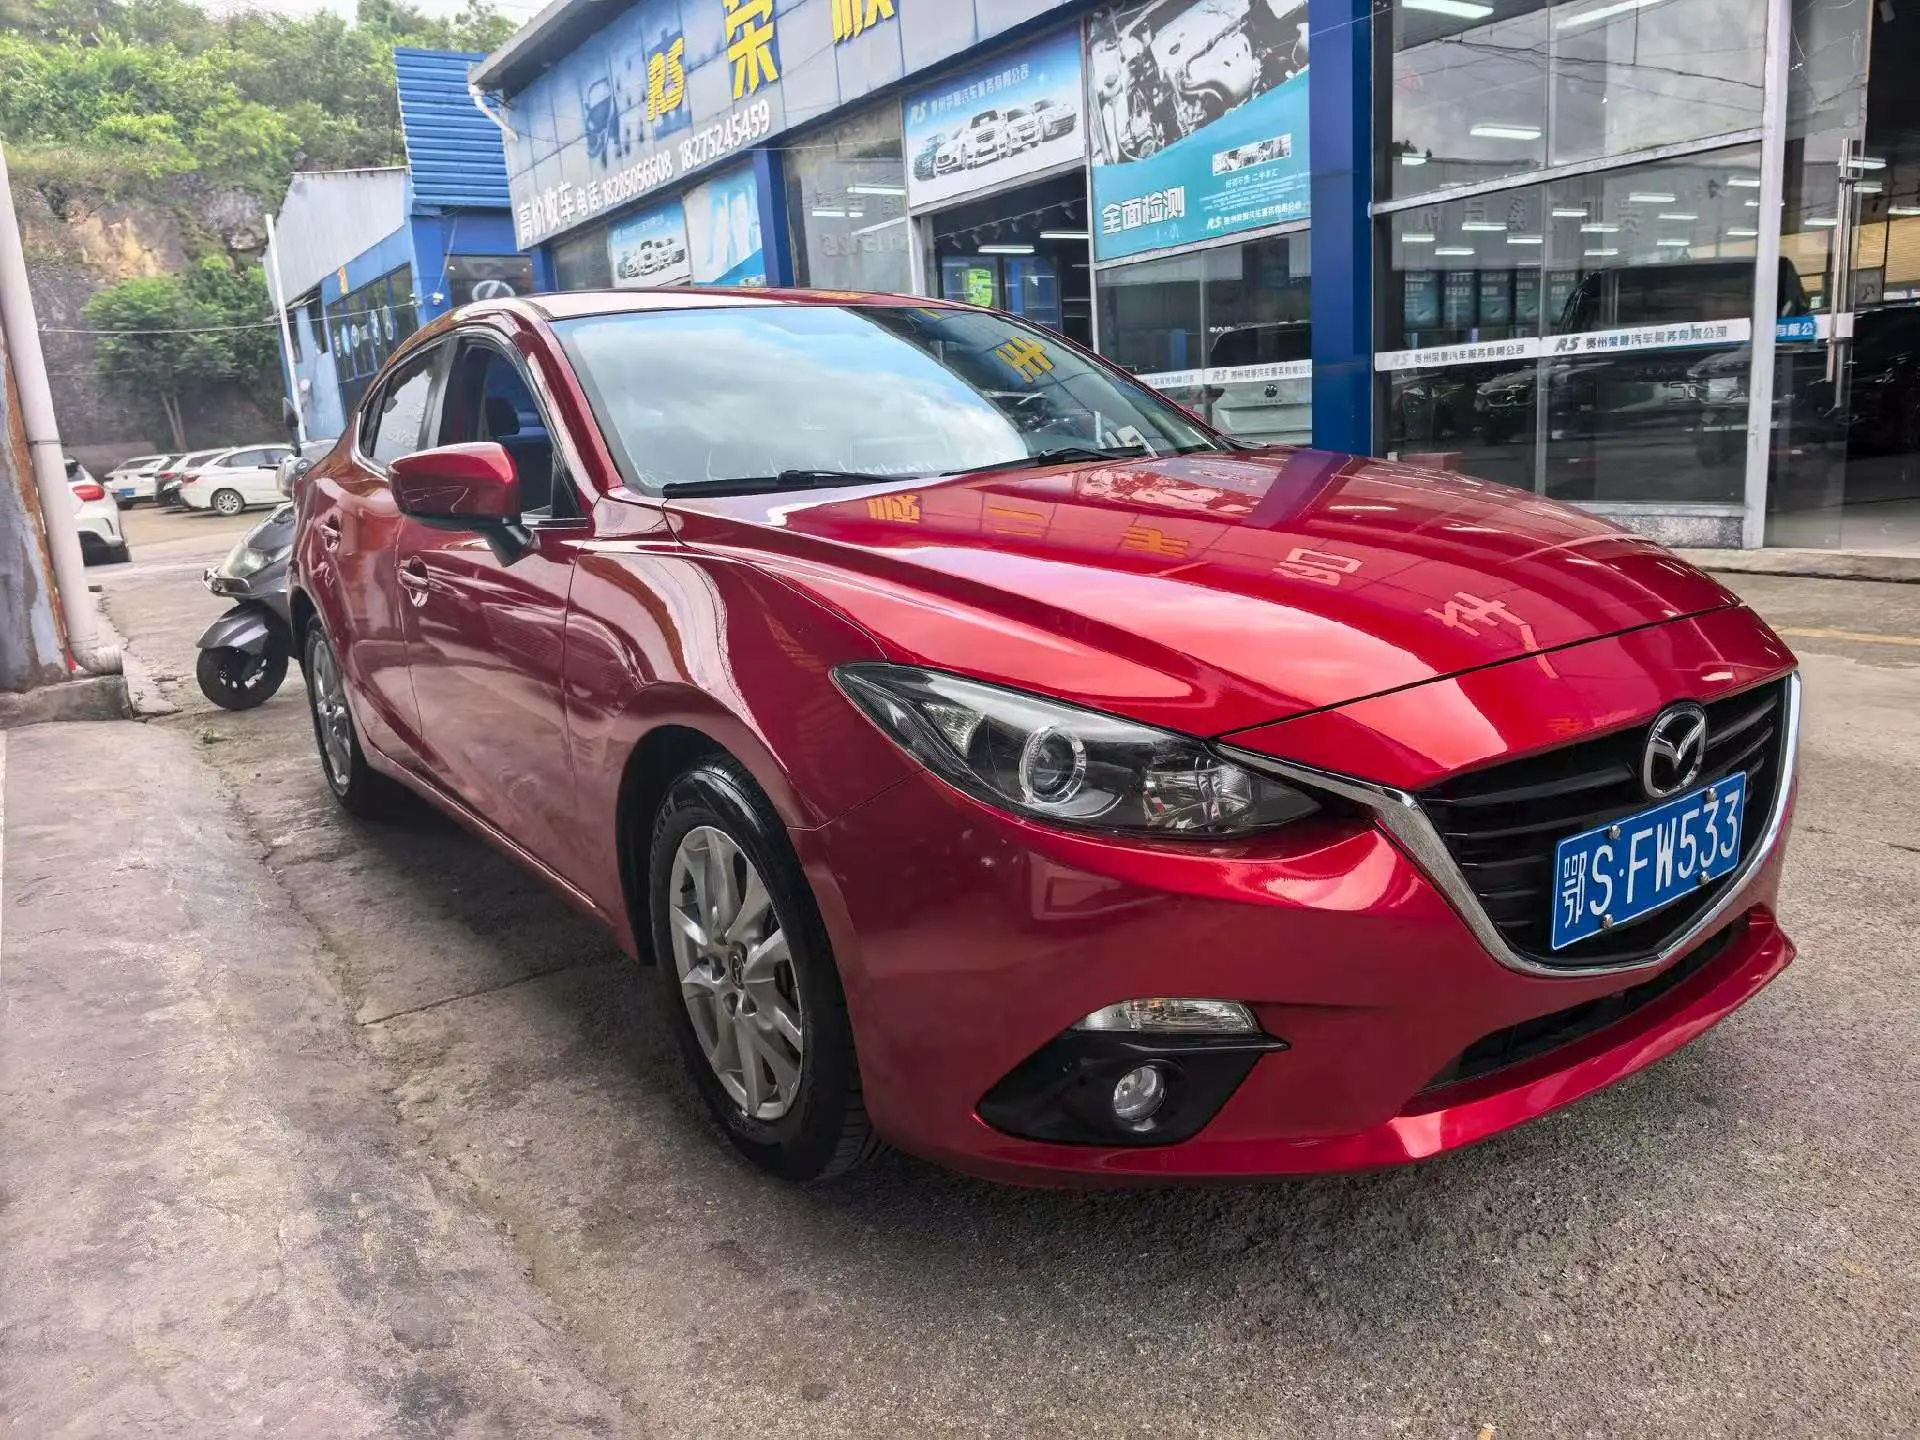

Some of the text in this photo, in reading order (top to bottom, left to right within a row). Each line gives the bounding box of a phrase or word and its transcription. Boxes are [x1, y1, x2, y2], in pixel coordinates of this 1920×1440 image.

[518, 181, 576, 243] 高价收车
[1101, 186, 1185, 235] 全面检测
[1555, 335, 1581, 353] RS
